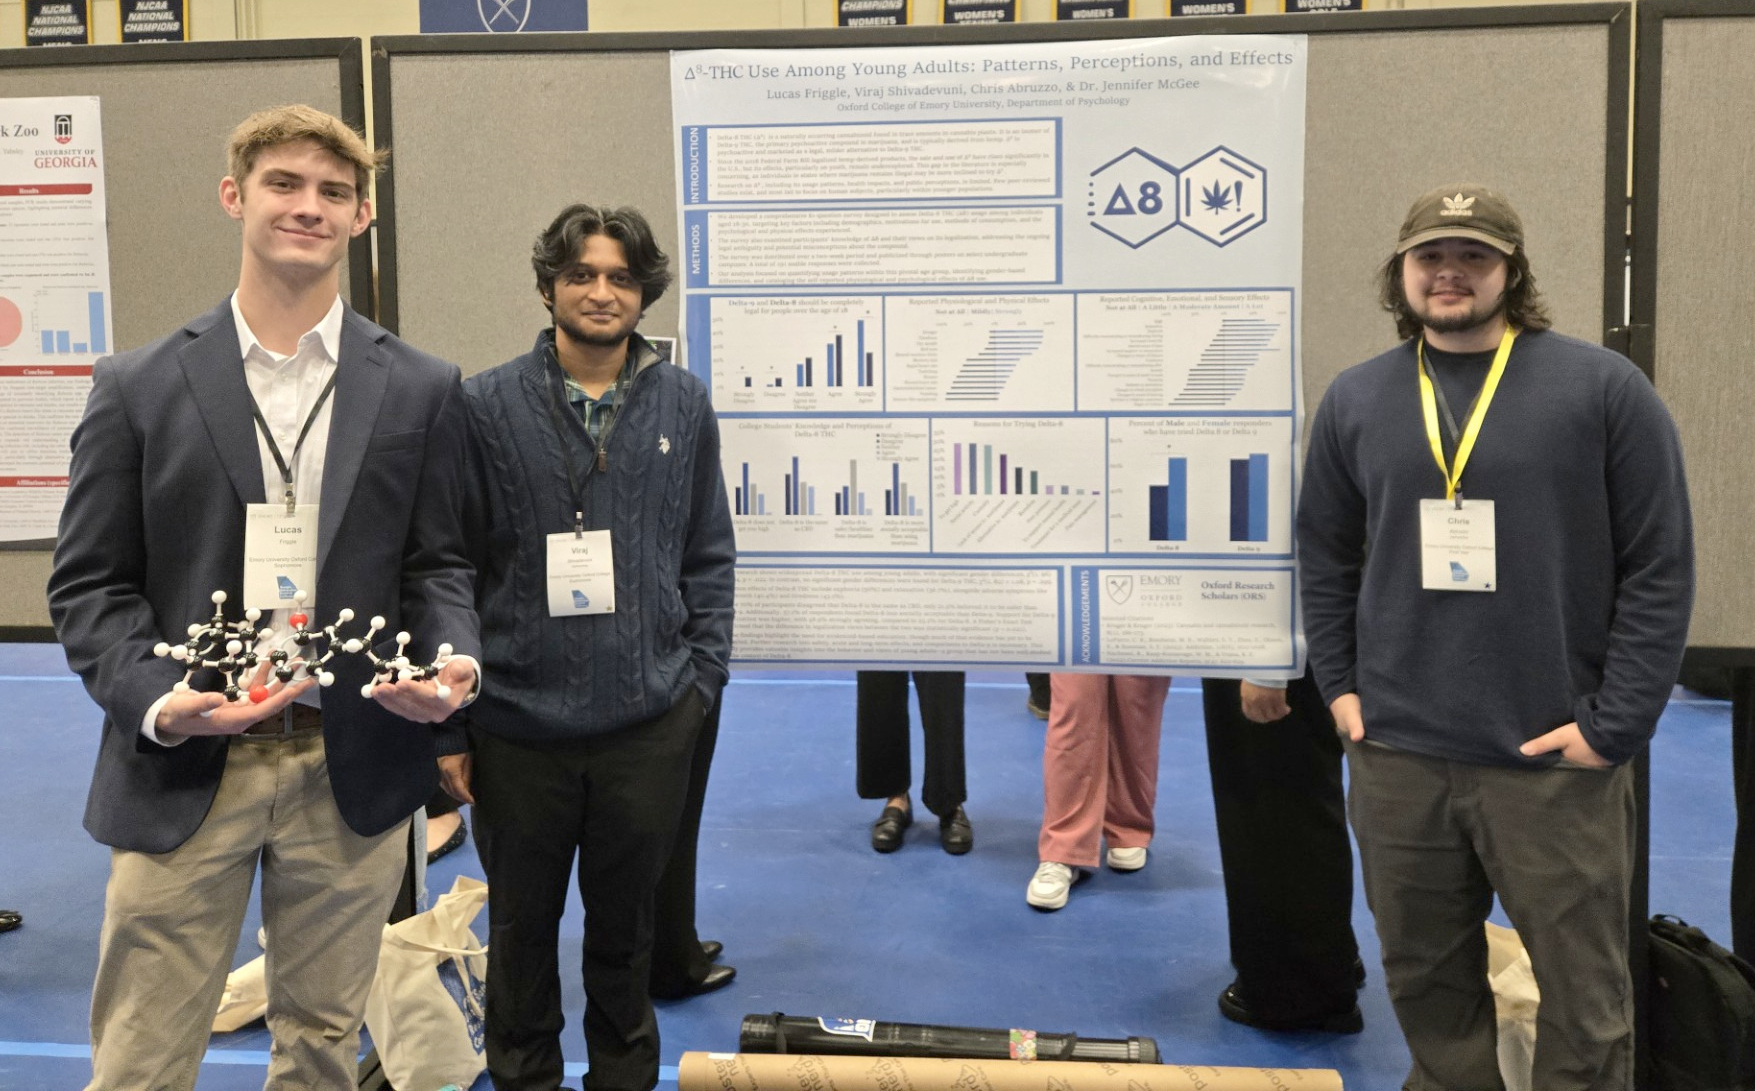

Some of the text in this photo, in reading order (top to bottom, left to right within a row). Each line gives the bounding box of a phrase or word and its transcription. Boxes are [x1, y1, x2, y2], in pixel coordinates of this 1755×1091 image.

[40, 4, 72, 14] NJCAA
[136, 1, 168, 10] NJCAA
[841, 1, 903, 11] CHAMPIONS
[1181, 3, 1235, 14] WOMEN'S
[126, 11, 174, 21] NATIONAL
[954, 10, 1005, 20] WOMEN'S
[1072, 9, 1114, 18] WOMEN'S
[32, 14, 78, 25] NATIONAL
[848, 17, 897, 27] WOMEN'S
[27, 26, 85, 36] CHAMPIONS
[124, 23, 180, 33] CHAMPIONS
[748, 64, 780, 78] Use
[785, 63, 846, 81] Among
[852, 61, 907, 80] Young
[912, 59, 976, 75] Adults:
[982, 56, 1062, 74] Patterns,
[1070, 53, 1182, 73] Perceptions,
[1190, 52, 1222, 66] and
[1230, 51, 1294, 66] Effects
[767, 79, 1200, 101] Lucas Friggle, Viraj Shivadevuni, Chris Abruzzo, & Dr. Jennifer McGee
[837, 96, 1130, 113] Oxford College of Emory University, Department of Psychology
[14, 125, 39, 137] Zoo
[34, 156, 97, 169] GEORGIA
[690, 127, 699, 205] INTRODUCTION
[691, 225, 700, 275] METHODS
[830, 298, 864, 306] completely
[1232, 420, 1272, 428] responders
[1447, 517, 1470, 525] Chris
[274, 526, 303, 534] Lucas
[571, 547, 589, 555] Viraj
[1140, 575, 1182, 585] EMORY
[1201, 581, 1275, 590] Oxford Research
[1201, 592, 1266, 602] Scholars (ORS)
[1081, 570, 1090, 663] ACKNOWLEDGEMENTS
